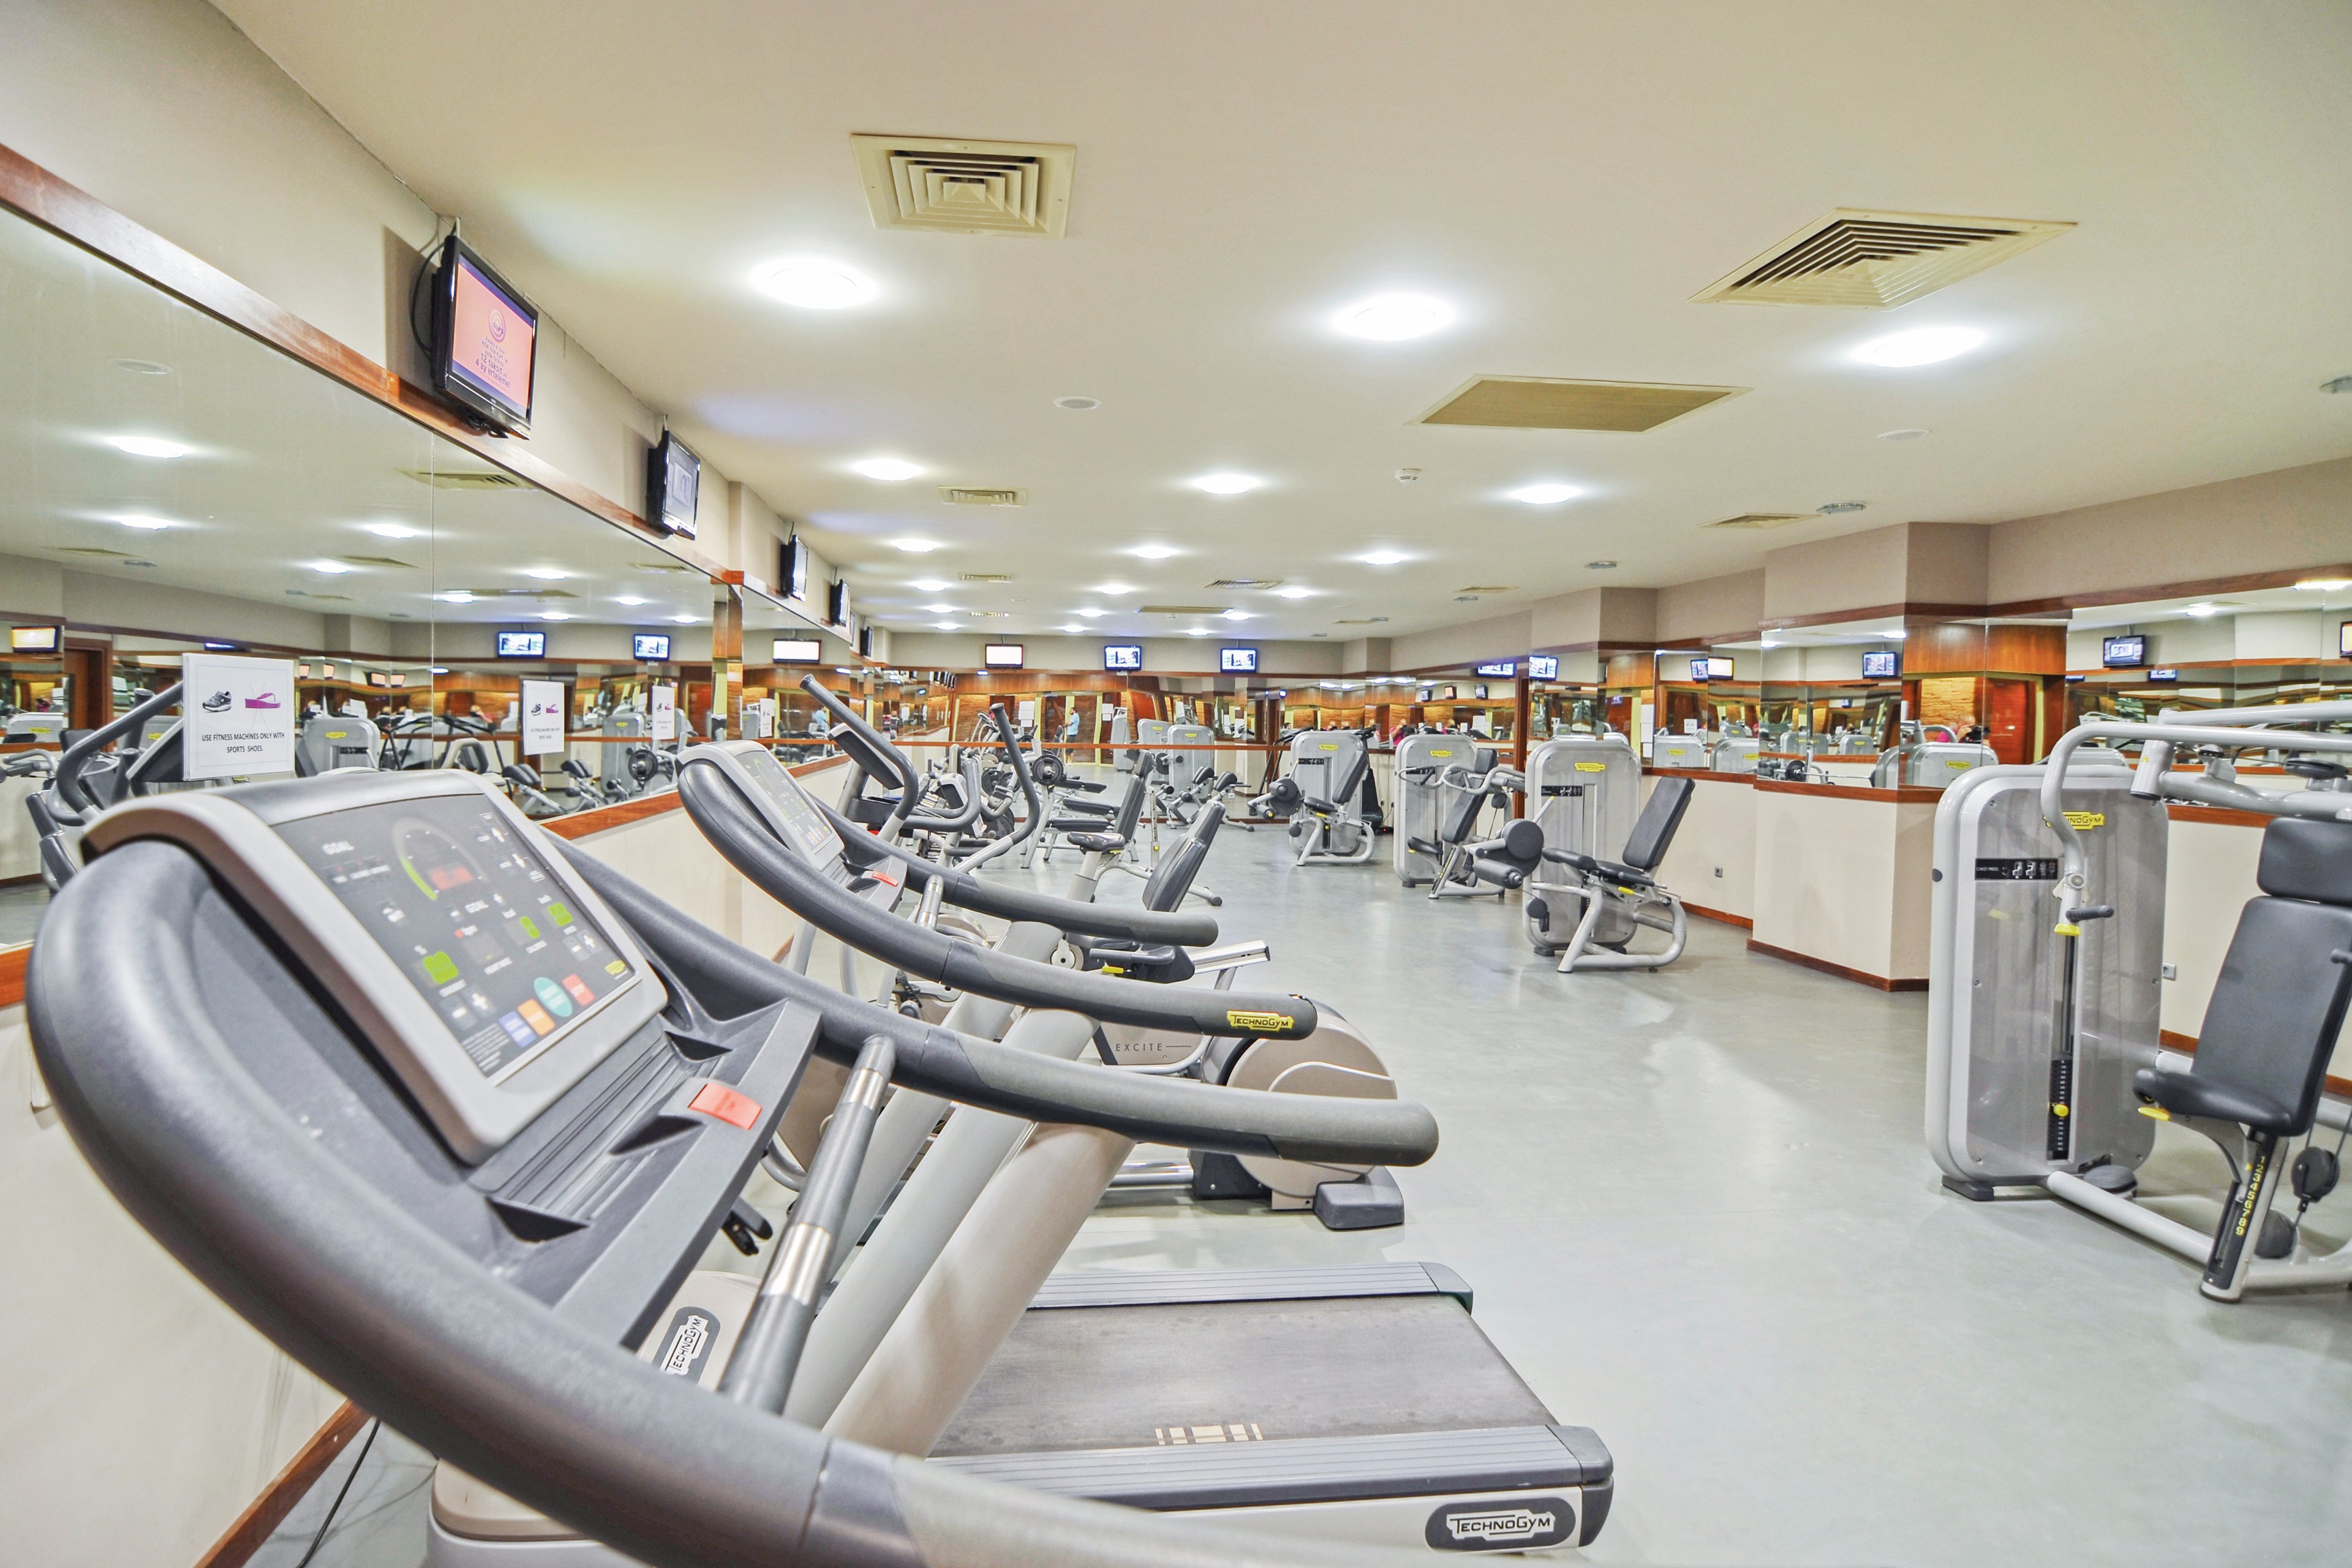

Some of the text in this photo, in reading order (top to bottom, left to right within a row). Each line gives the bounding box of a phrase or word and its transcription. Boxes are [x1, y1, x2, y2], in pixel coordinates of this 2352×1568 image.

[488, 359, 502, 374] taksit
[1115, 1042, 1163, 1052] EXCITE
[2255, 1164, 2264, 1173] 2
[2252, 1173, 2261, 1182] 3
[2250, 1182, 2258, 1191] 4
[2247, 1191, 2256, 1200] 5
[2244, 1200, 2252, 1209] 6
[2242, 1208, 2250, 1217] 7
[2238, 1217, 2246, 1226] 8
[2235, 1226, 2244, 1235] 9
